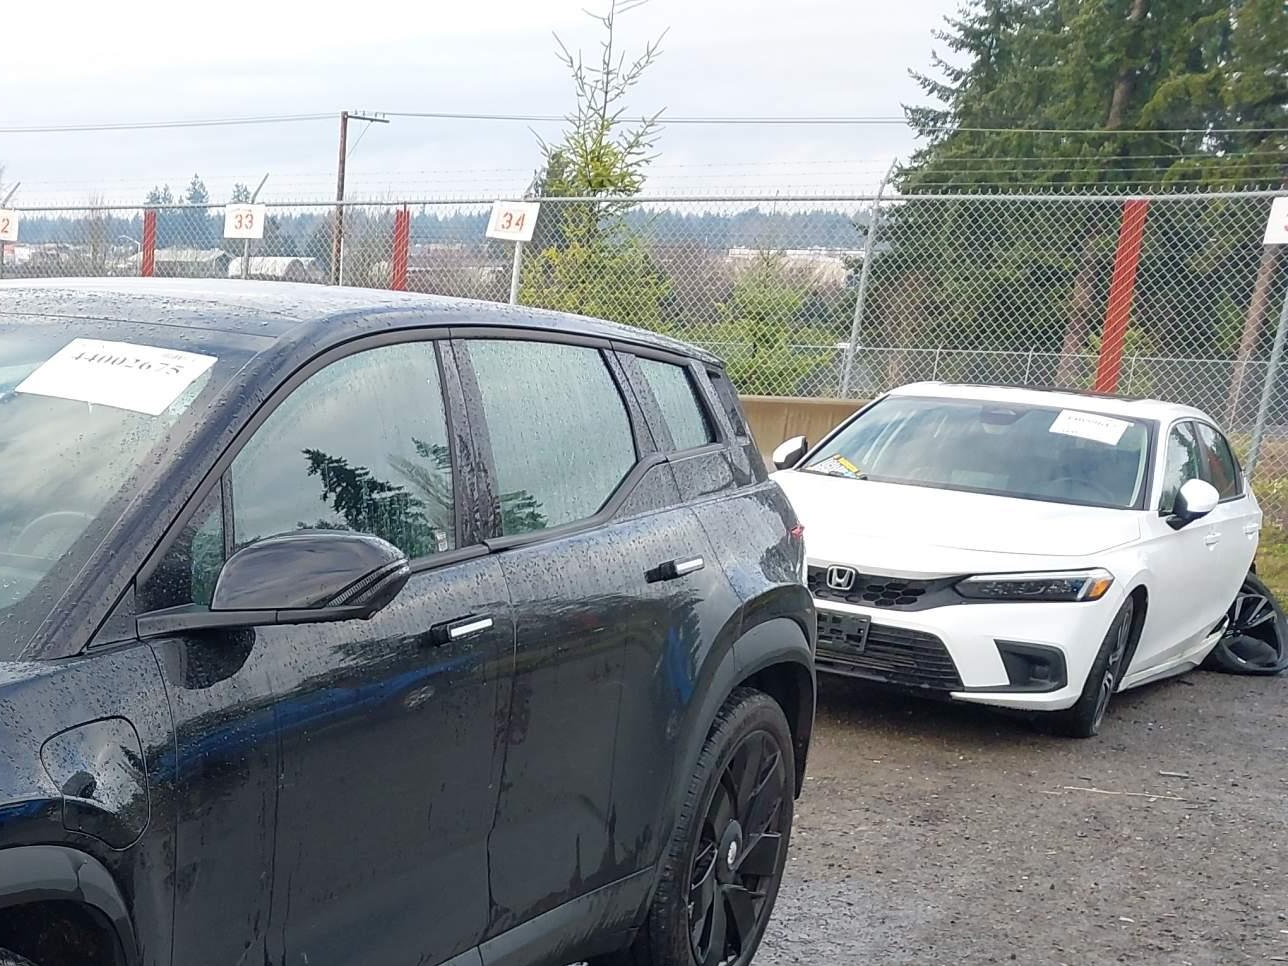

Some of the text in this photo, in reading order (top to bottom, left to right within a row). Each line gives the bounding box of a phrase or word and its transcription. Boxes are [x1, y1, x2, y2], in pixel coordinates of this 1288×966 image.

[234, 213, 254, 230] 33
[501, 211, 526, 231] 34
[71, 351, 185, 375] 44002675
